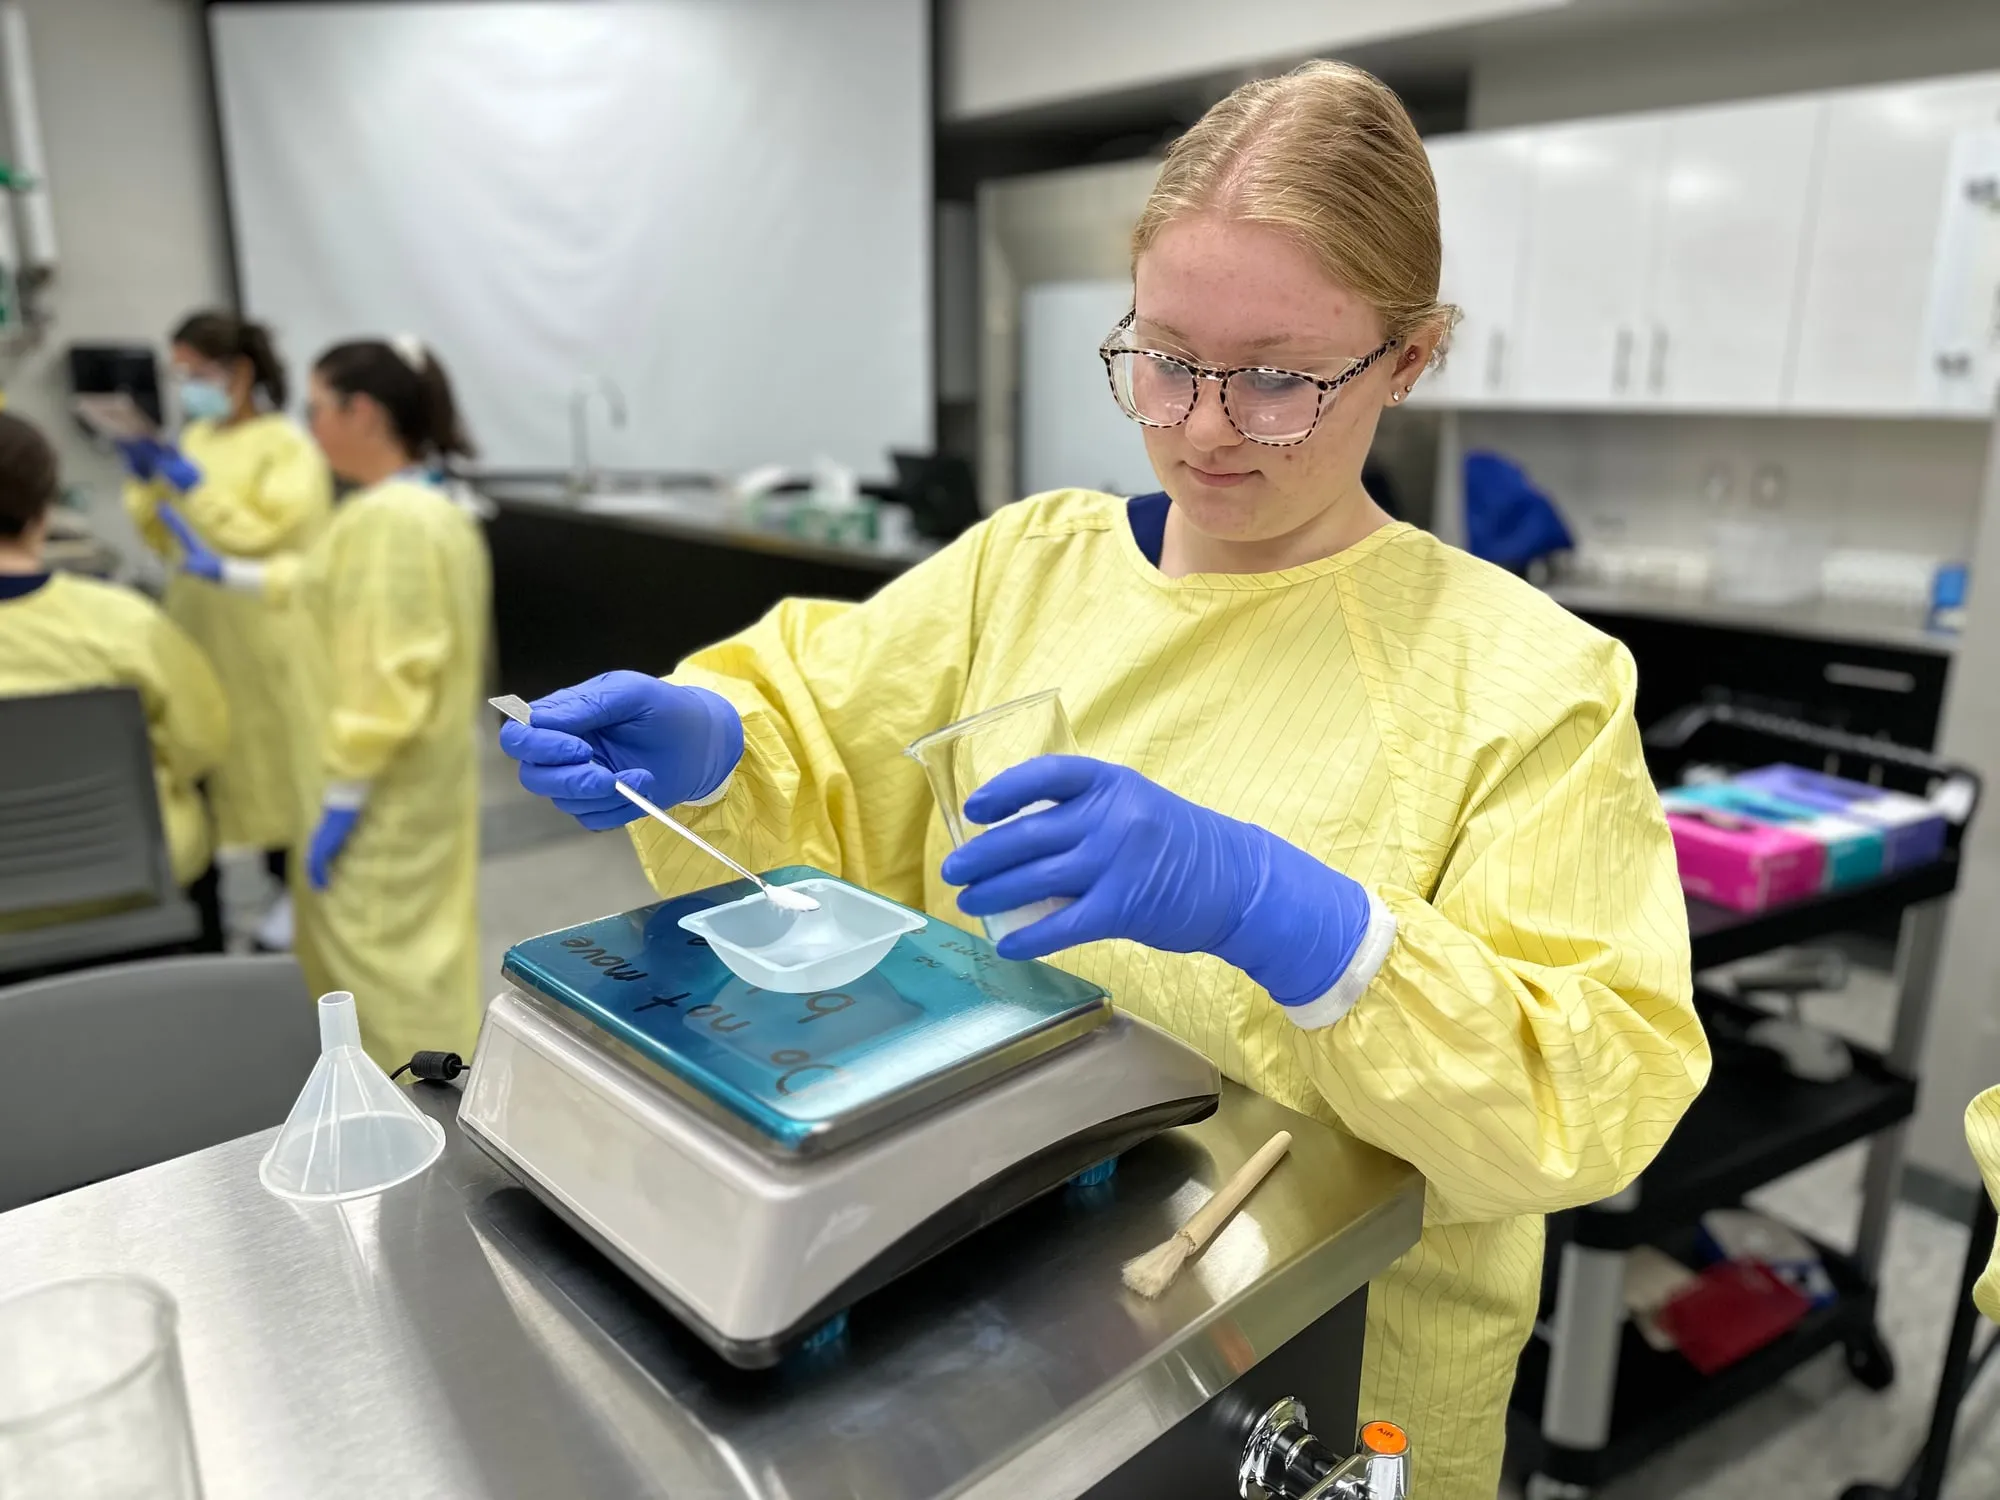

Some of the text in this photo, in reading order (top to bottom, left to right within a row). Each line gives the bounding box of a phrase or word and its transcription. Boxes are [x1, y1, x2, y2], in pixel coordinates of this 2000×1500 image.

[560, 936, 648, 981] move
[633, 992, 751, 1032] not
[770, 1049, 849, 1096] Do
